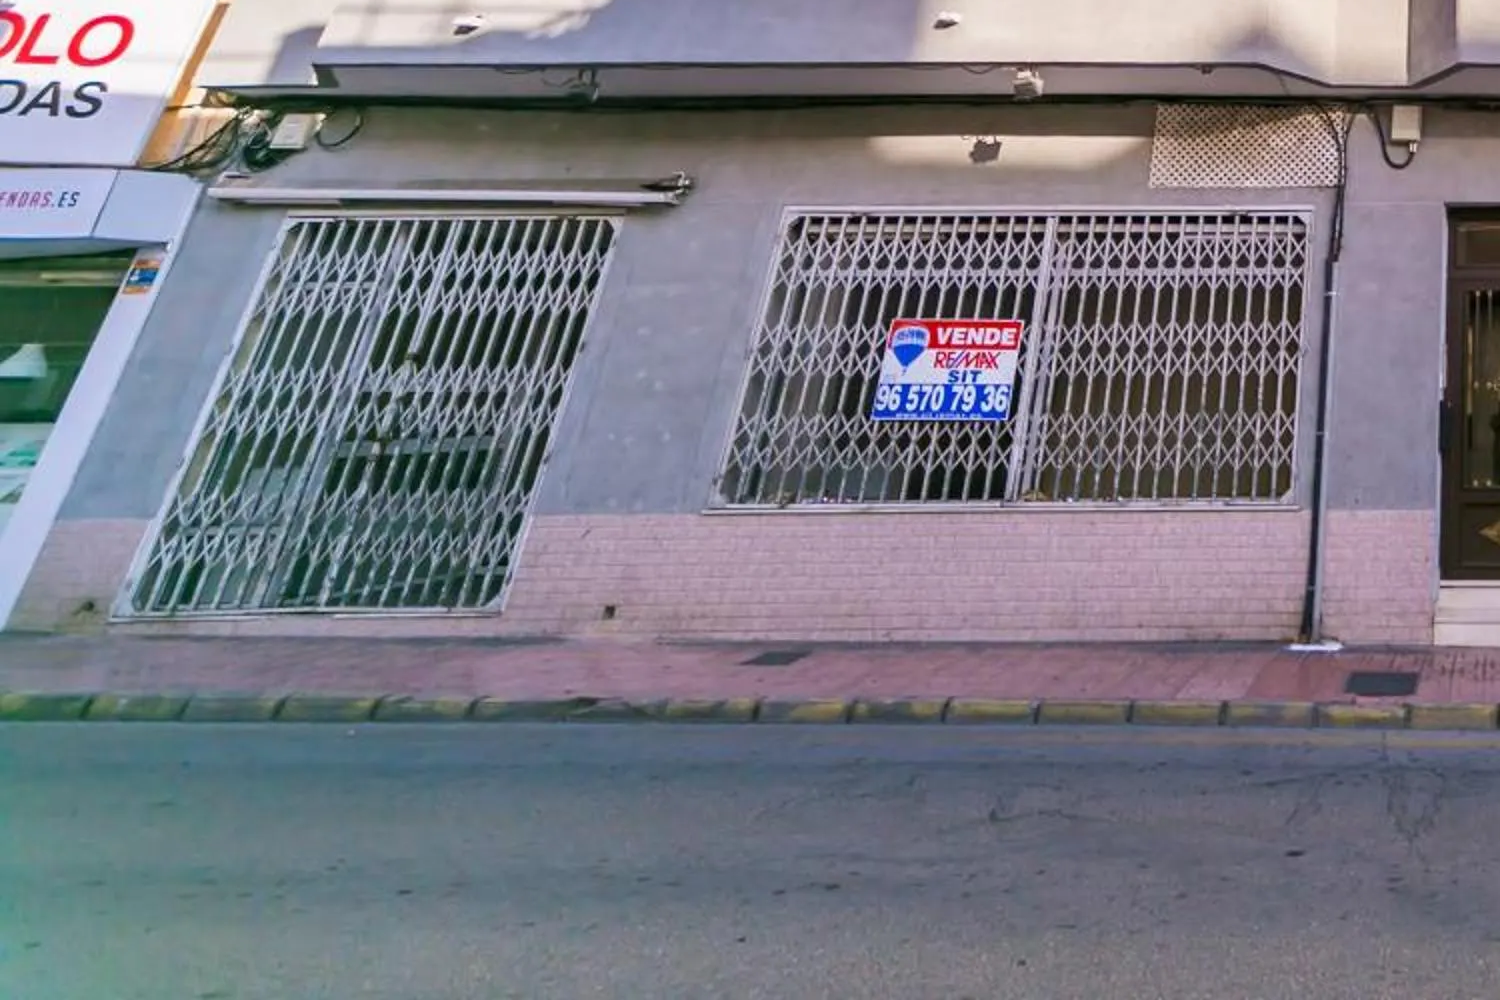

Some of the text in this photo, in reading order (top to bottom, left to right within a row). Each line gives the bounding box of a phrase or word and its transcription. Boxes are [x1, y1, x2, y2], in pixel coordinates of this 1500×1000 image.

[936, 327, 1017, 346] VENDE
[933, 350, 1001, 370] RE/MAX
[947, 370, 983, 383] SIT
[875, 385, 1009, 411] 96 570 79 36
